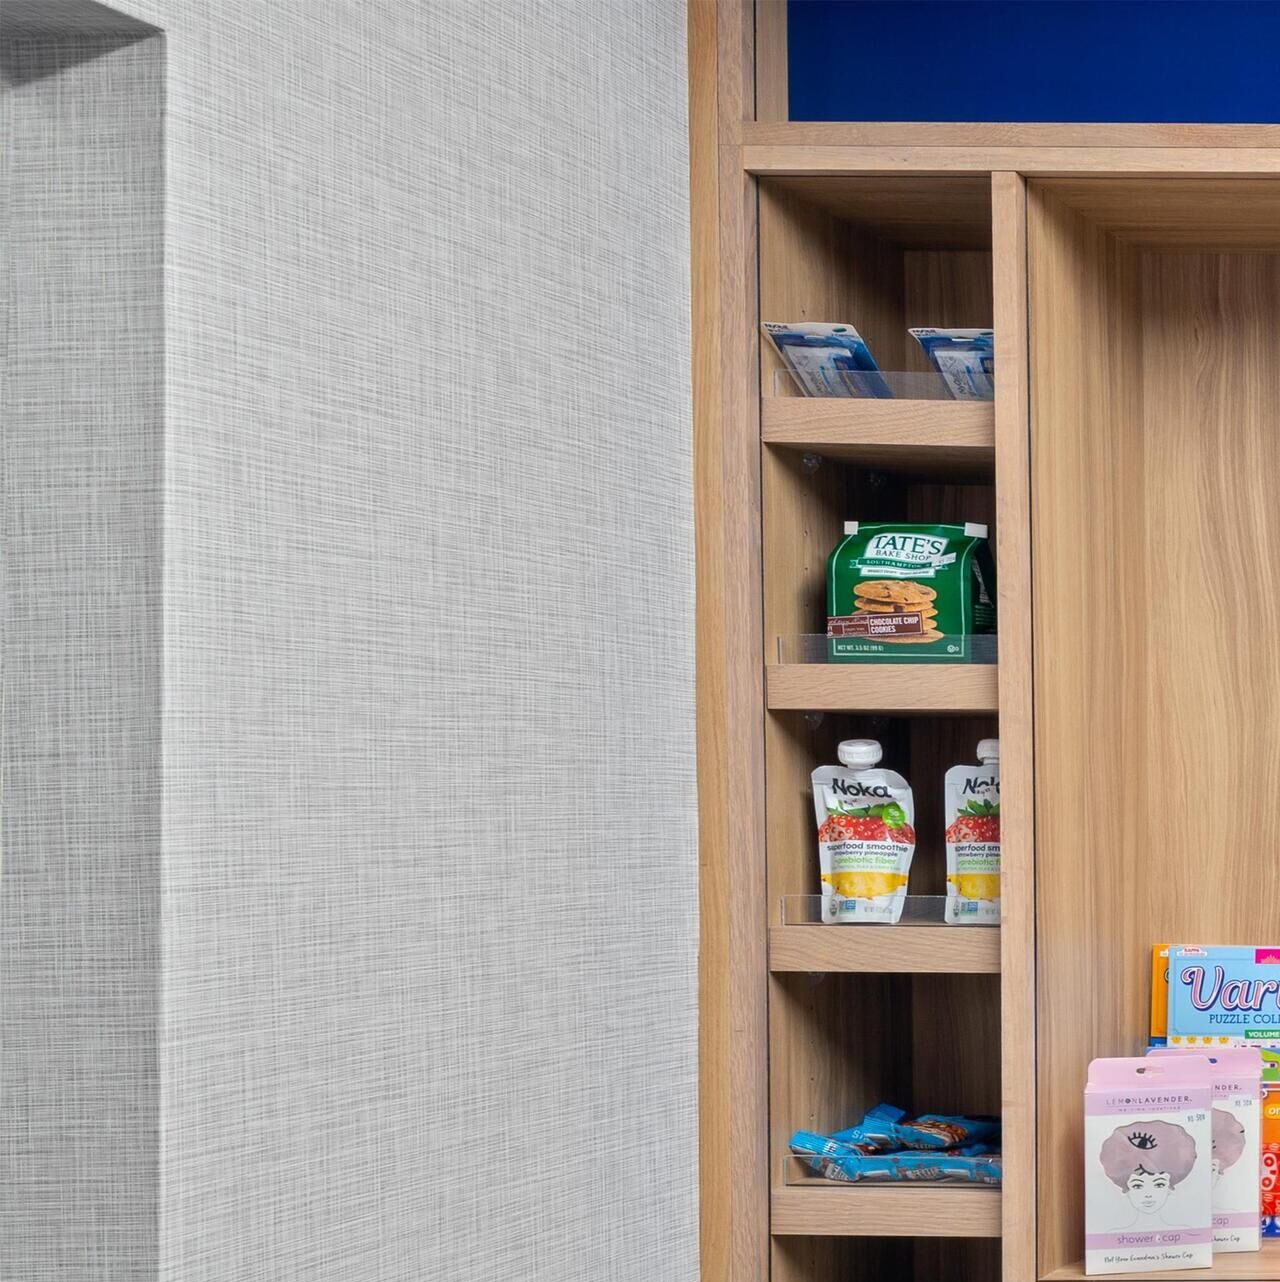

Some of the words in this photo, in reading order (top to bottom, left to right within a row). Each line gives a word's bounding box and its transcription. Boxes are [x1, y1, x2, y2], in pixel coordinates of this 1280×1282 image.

[874, 533, 943, 555] TATE'S
[870, 616, 903, 626] CHOCOLATE
[904, 616, 919, 625] CHIP
[832, 778, 893, 798] Noka
[1209, 1014, 1250, 1025] PUZZLE
[1117, 1234, 1154, 1245] shower
[1161, 1233, 1181, 1246] cap
